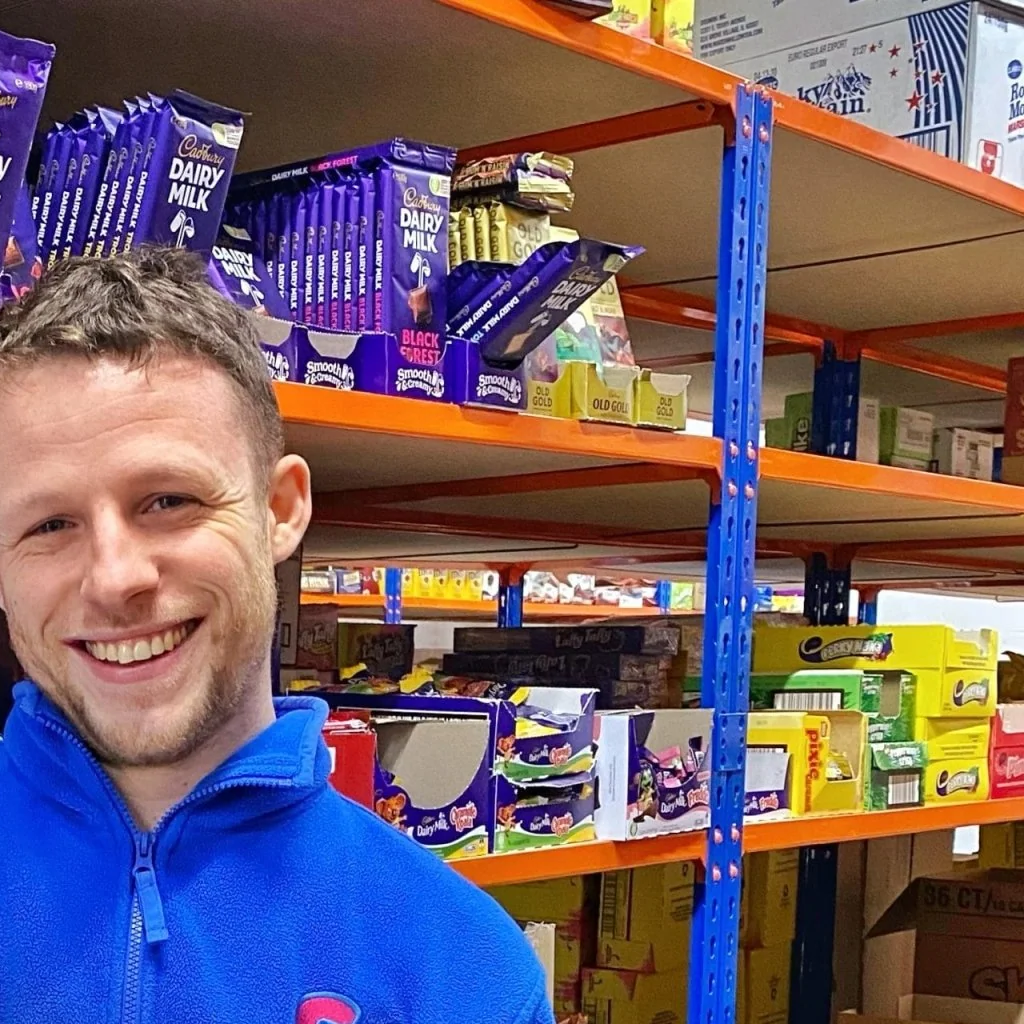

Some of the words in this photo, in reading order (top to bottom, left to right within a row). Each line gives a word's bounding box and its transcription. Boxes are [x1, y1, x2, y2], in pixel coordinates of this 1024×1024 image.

[178, 134, 226, 166] Cadbury
[168, 157, 224, 188] DAIRY
[136, 171, 148, 204] DAIRY
[41, 192, 52, 223] DAIRY
[168, 186, 210, 212] MILK
[402, 186, 441, 214] Cadbury
[129, 202, 141, 228] MILK
[400, 208, 444, 233] DAIRY
[37, 222, 47, 247] MILK
[402, 228, 438, 253] MILK
[212, 246, 254, 268] DAIRY
[221, 261, 261, 282] MILK
[552, 281, 597, 298] DAIRY
[541, 294, 577, 310] MILK
[401, 329, 440, 350] BLACK
[399, 345, 441, 365] FOREST
[397, 368, 432, 383] Smooth
[479, 374, 511, 389] Smooth
[536, 386, 550, 396] OLD
[660, 397, 672, 406] OLD
[532, 397, 553, 407] GOLD
[593, 398, 610, 411] OLD
[611, 401, 629, 414] GOLD
[656, 406, 674, 417] GOLD
